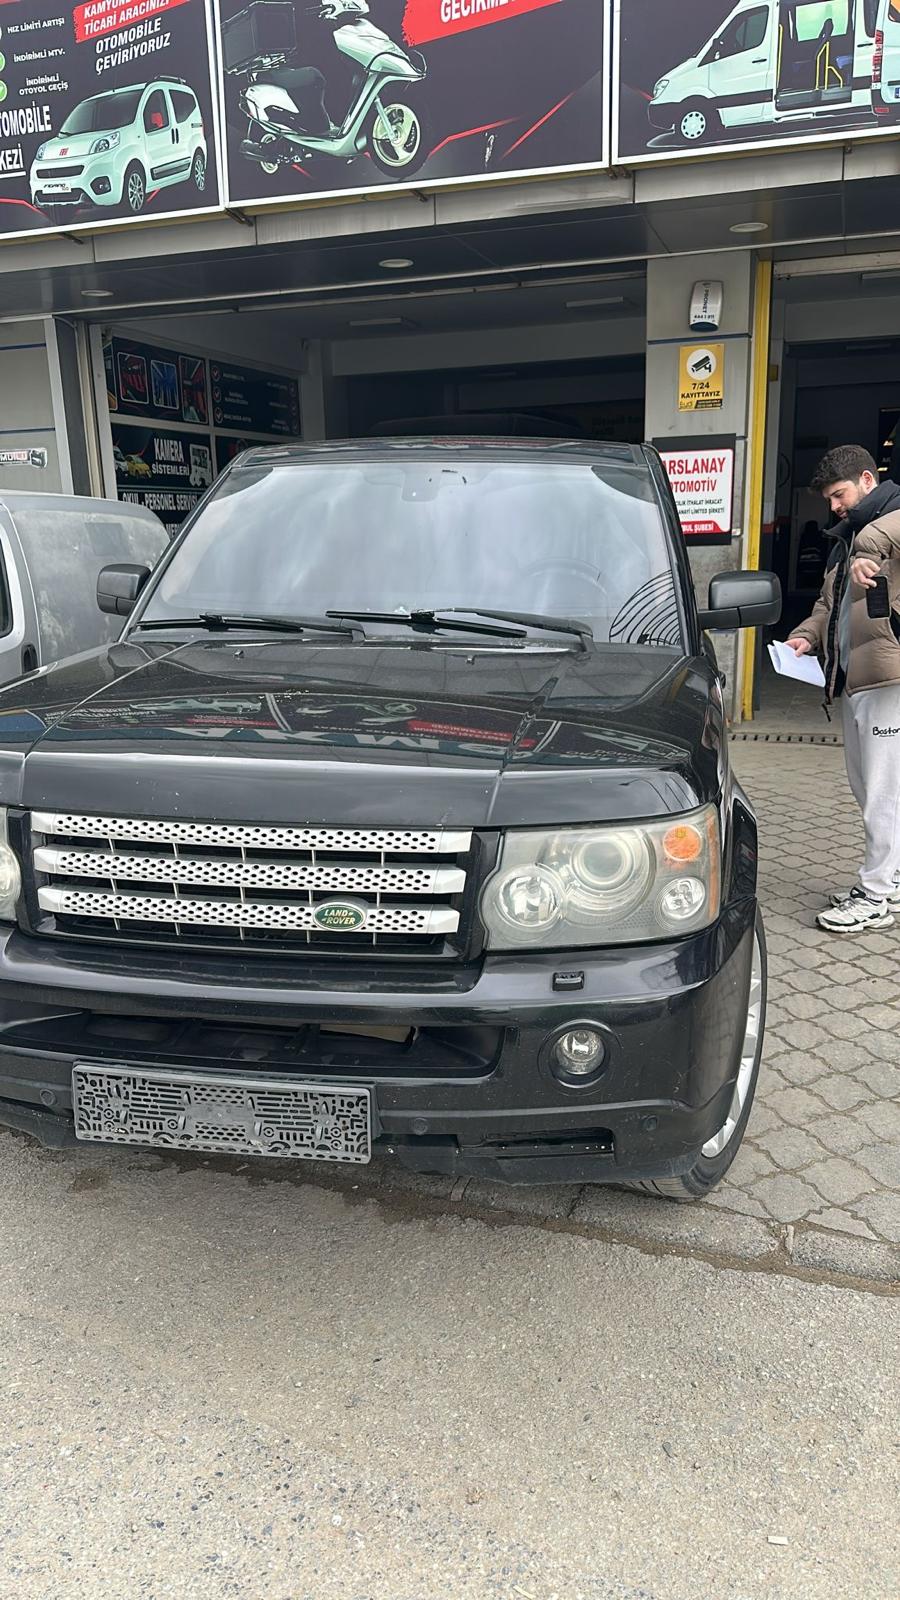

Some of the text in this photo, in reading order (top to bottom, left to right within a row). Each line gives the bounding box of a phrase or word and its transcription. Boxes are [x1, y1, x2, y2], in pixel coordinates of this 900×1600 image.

[7, 17, 65, 34] HIZ LİMİTİ ARTIŞI
[84, 11, 116, 35] TİCARİ
[95, 18, 161, 54] OTOMOBİLE
[13, 48, 66, 63] İNDİRİMLİ MTV.
[95, 32, 171, 76] ÇEVİRİYORUZ
[26, 73, 60, 86] İNDİRİMLİ
[19, 80, 69, 95] OTOYOL GEÇİŞ
[691, 382, 710, 391] 7/24
[680, 391, 721, 399] KAYITTAYIZ
[153, 438, 185, 463] KAMERA
[151, 461, 190, 476] SİSTEMLERİ
[325, 909, 348, 917] LAND
[326, 917, 356, 925] ROVER
